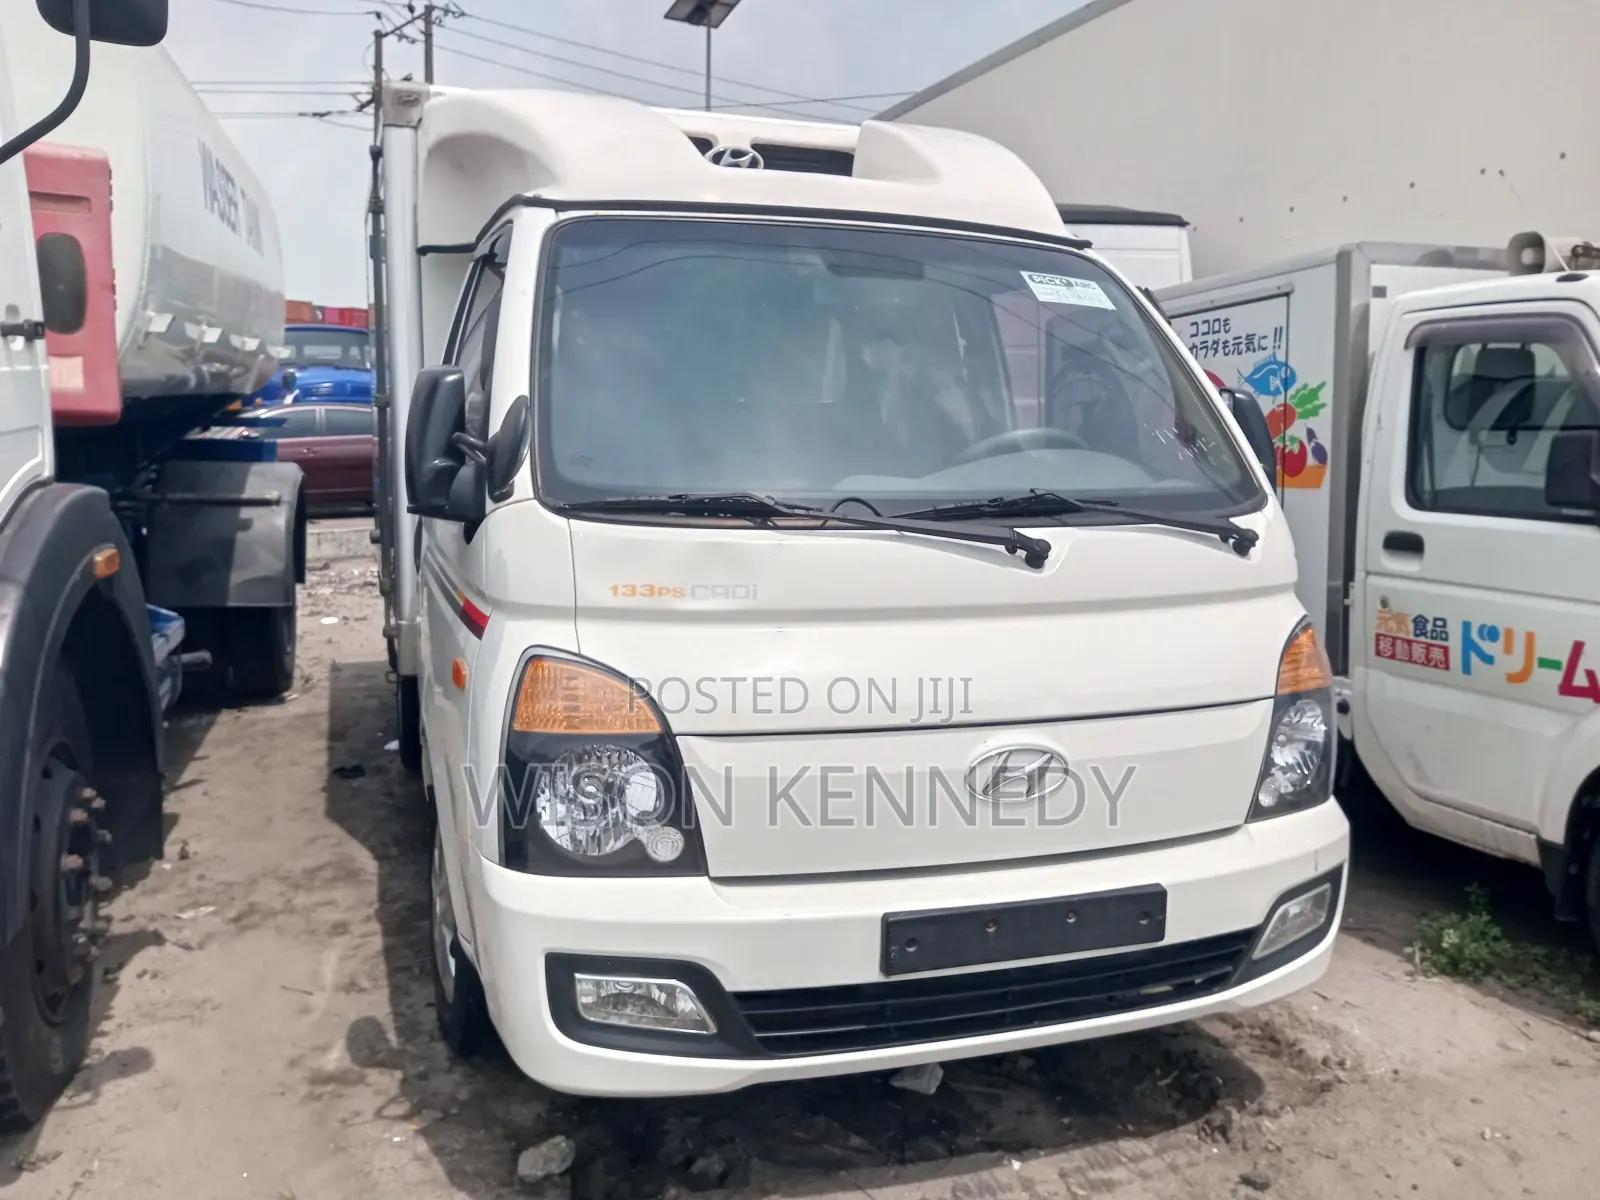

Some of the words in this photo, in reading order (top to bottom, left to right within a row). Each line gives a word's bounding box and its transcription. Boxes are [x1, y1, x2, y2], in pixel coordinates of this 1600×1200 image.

[1189, 317, 1232, 338] ココロも
[1378, 635, 1447, 668] 移動販売
[1461, 620, 1600, 704] ドリーム
